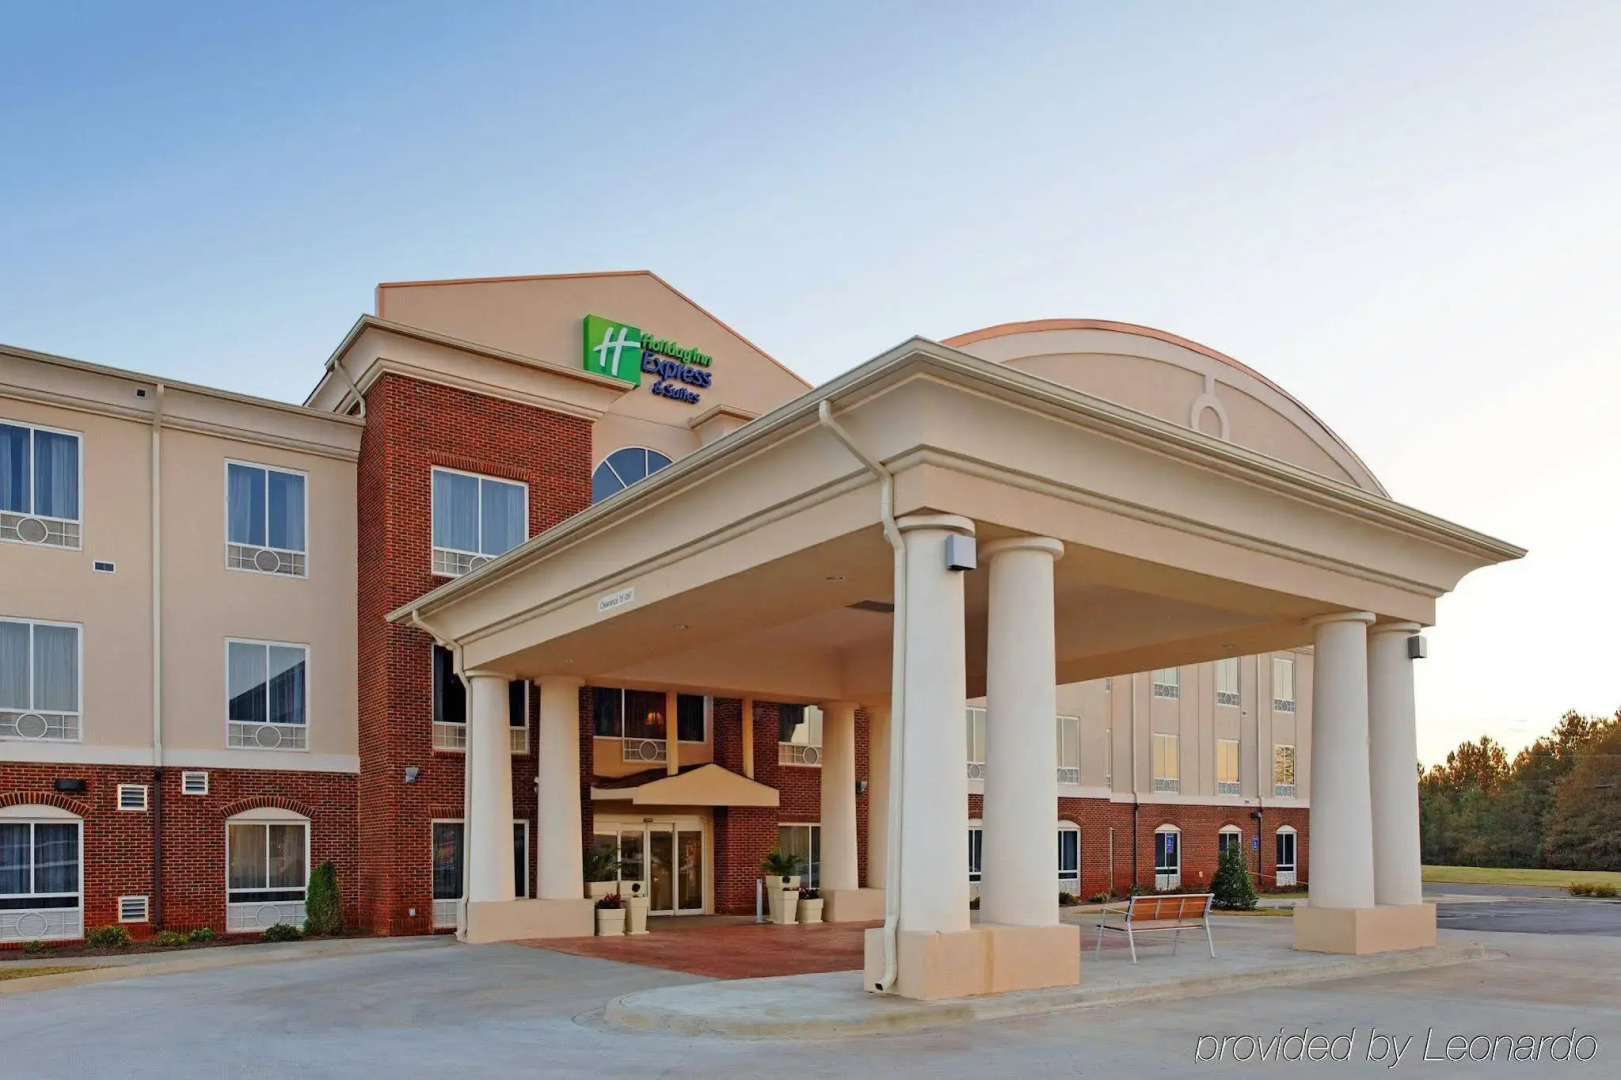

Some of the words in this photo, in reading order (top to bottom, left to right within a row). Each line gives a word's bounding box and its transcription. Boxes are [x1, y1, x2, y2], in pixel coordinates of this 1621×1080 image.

[641, 333, 692, 365] Holiday
[640, 350, 713, 388] Express
[651, 381, 663, 395] &
[663, 383, 701, 404] Suites
